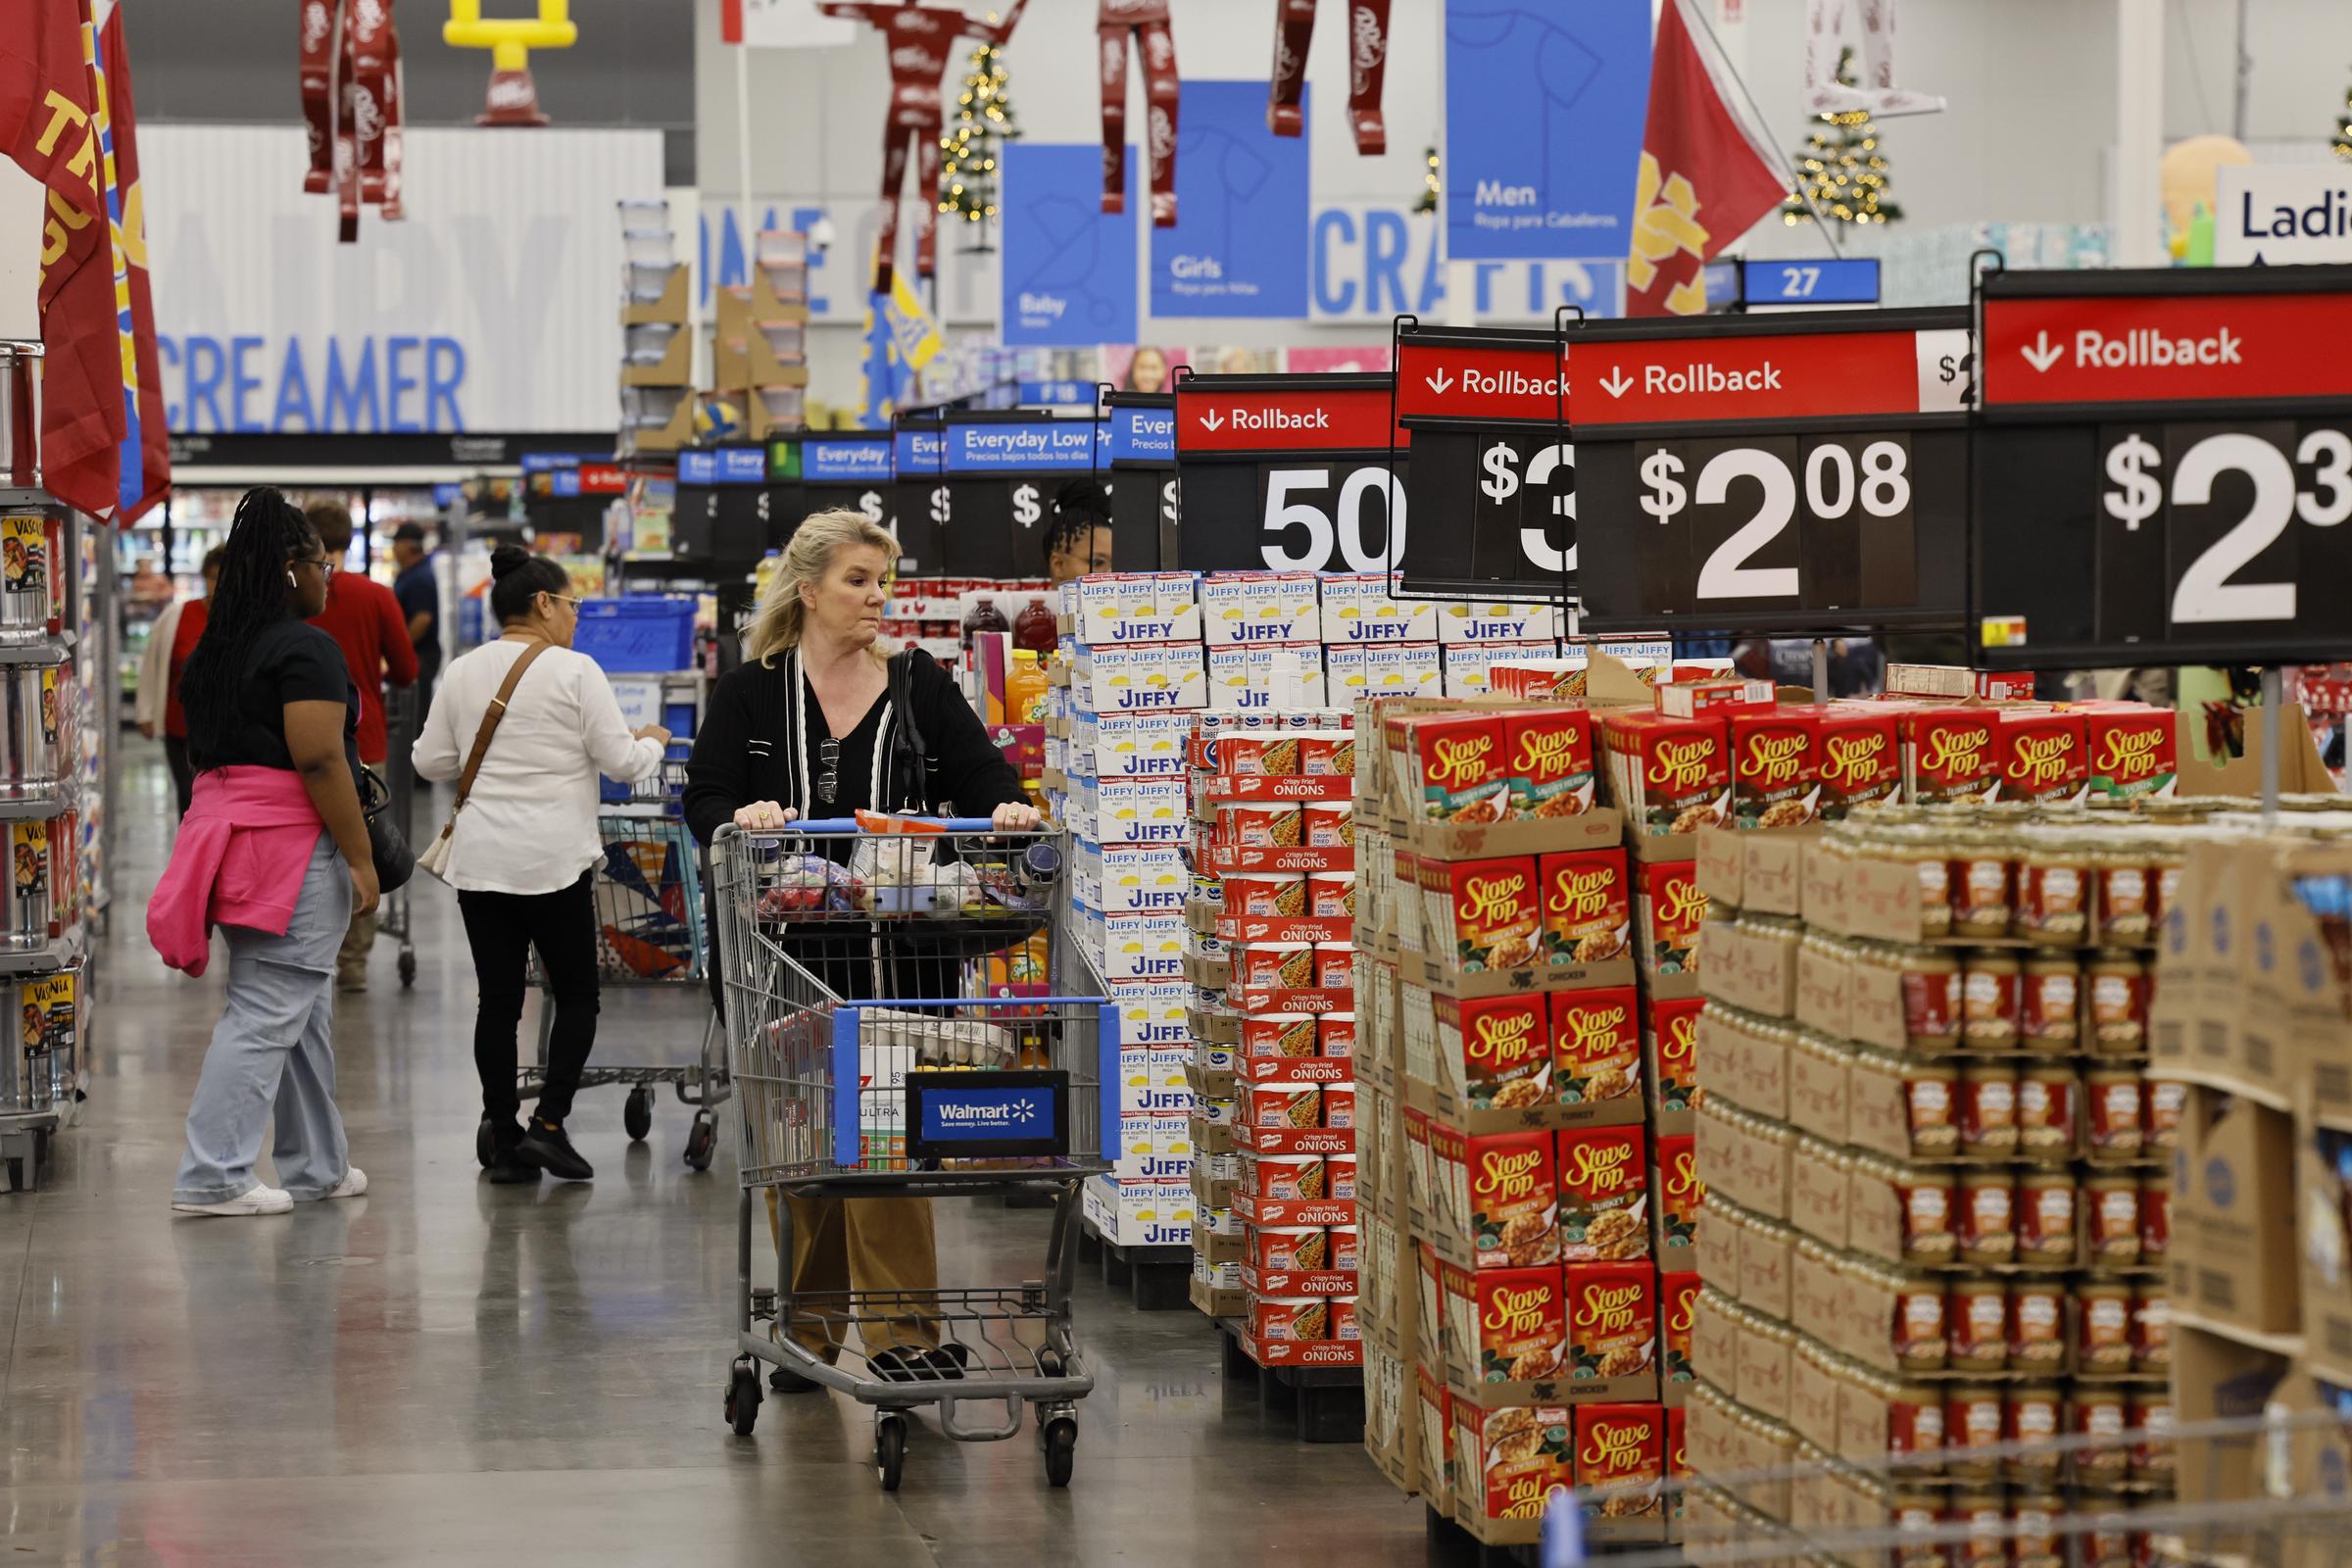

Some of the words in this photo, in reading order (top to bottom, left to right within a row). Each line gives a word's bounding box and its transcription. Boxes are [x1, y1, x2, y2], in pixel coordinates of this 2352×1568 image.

[1475, 179, 1537, 207] Men
[2241, 189, 2352, 238] Ladi
[1172, 255, 1222, 278] Girls
[1782, 268, 1821, 297] 27
[1020, 293, 1066, 318] Baby
[2076, 326, 2242, 368] Rollback
[156, 335, 466, 432] CREAMER
[1462, 368, 1570, 396] Rollback
[1644, 361, 1782, 395] Rollback
[1232, 407, 1329, 429] Rollback
[965, 430, 1047, 452] Everyday
[1053, 429, 1088, 447] Low
[816, 446, 886, 465] Everyday
[965, 452, 1001, 463] Precios
[1002, 451, 1026, 464] bajos
[1027, 451, 1054, 462] todos
[1055, 451, 1069, 461] los
[1260, 466, 1407, 572] 50
[1083, 586, 1115, 597] JIFFY
[1119, 584, 1152, 595] JIFFY
[1158, 582, 1191, 593] JIFFY
[1207, 587, 1240, 598] JIFFY
[1245, 585, 1277, 596] JIFFY
[1131, 652, 1164, 662] JIFFY
[1168, 650, 1200, 661] JIFFY
[1211, 654, 1245, 664] JIFFY
[1330, 654, 1363, 664] JIFFY
[1448, 652, 1481, 662] JIFFY
[1100, 719, 1133, 730] JIFFY
[1428, 735, 1494, 780] Stove
[1513, 727, 1579, 772] Stove
[1648, 738, 1715, 783] Stove
[1740, 734, 1808, 776] Stove
[1821, 734, 1886, 779] Stove
[1922, 727, 1990, 770] Stove
[2008, 732, 2074, 778] Stove
[2097, 728, 2164, 771] Stove
[1454, 759, 1488, 788] Top
[1539, 751, 1572, 780] Top
[1675, 762, 1707, 792] Top
[1764, 758, 1800, 785] Top
[1846, 759, 1879, 787] Top
[1947, 752, 1981, 779] Top
[2034, 758, 2067, 787] Top
[2123, 752, 2156, 780] Top
[1101, 786, 1133, 797] JIFFY
[1274, 784, 1325, 796] ONIONS
[1676, 792, 1709, 808] TURKEY
[1766, 787, 1798, 803] TURKEY
[1847, 787, 1881, 805] TURKEY
[1946, 780, 1980, 797] TURKEY
[1103, 853, 1137, 863] JIFFY
[1276, 858, 1328, 868] ONIONS
[1459, 873, 1525, 920] Stove
[1549, 868, 1616, 912] Stove
[1487, 899, 1519, 928] Top
[1576, 892, 1608, 920] Top
[1107, 919, 1140, 930] JIFFY
[1145, 918, 1178, 929] JIFFY
[1281, 930, 1332, 941] ONIONS
[1290, 923, 1306, 932] Crispy
[1113, 987, 1146, 997] JIFFY
[1150, 986, 1183, 997] JIFFY
[1282, 1001, 1334, 1011] ONIONS
[1469, 1012, 1535, 1057] Stove
[1559, 1006, 1626, 1051] Stove
[1495, 1037, 1528, 1066] Top
[1586, 1030, 1618, 1058] Top
[1291, 1068, 1343, 1079] ONIONS
[859, 1108, 899, 1117] ULTRA
[939, 1102, 1009, 1120] Walmart
[1295, 1140, 1347, 1152] ONIONS
[1475, 1150, 1543, 1194] Stove
[1566, 1143, 1633, 1187] Stove
[1501, 1173, 1535, 1201] Top
[1592, 1166, 1625, 1195] Top
[1297, 1211, 1348, 1223] ONIONS
[1591, 1197, 1626, 1213] TURKEY
[1301, 1281, 1353, 1292] ONIONS
[1485, 1286, 1551, 1331] Stove
[1575, 1284, 1643, 1328] Stove
[1511, 1310, 1544, 1338] Top
[1601, 1308, 1634, 1336] Top
[1302, 1350, 1354, 1362] ONIONS
[1583, 1423, 1650, 1465] Stove
[1609, 1446, 1642, 1473] Top
